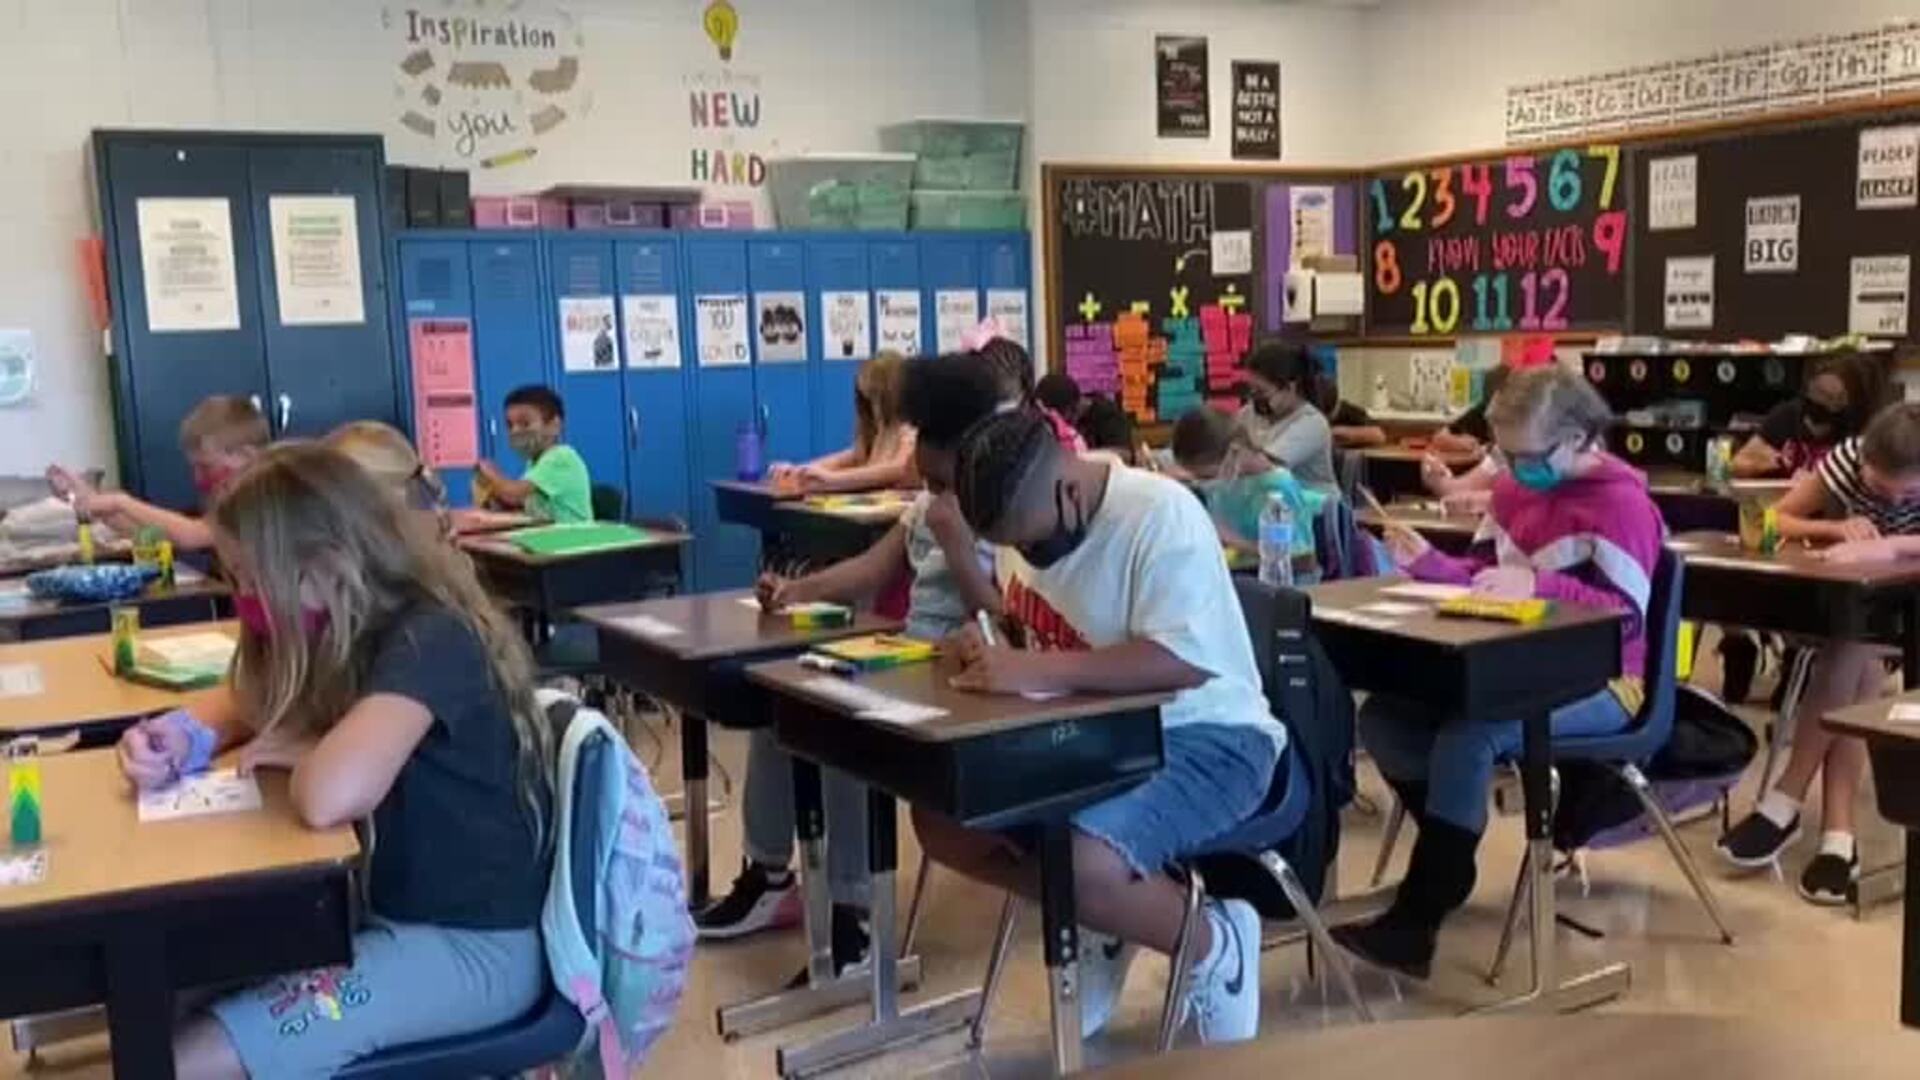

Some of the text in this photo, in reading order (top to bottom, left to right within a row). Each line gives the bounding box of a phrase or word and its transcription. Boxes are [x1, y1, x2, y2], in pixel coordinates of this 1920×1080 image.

[448, 108, 518, 158] you
[689, 91, 760, 129] NEW
[691, 148, 767, 187] HARD
[1400, 171, 1427, 230] 2
[1430, 167, 1456, 228] 3
[1461, 161, 1493, 226] 4
[1505, 155, 1537, 218] 5
[1548, 149, 1582, 211] 6
[1588, 144, 1620, 209] 7
[1374, 240, 1400, 293] 8
[1594, 211, 1626, 273] 9
[1749, 239, 1795, 264] BIG
[1410, 267, 1569, 334] 10 11 12
